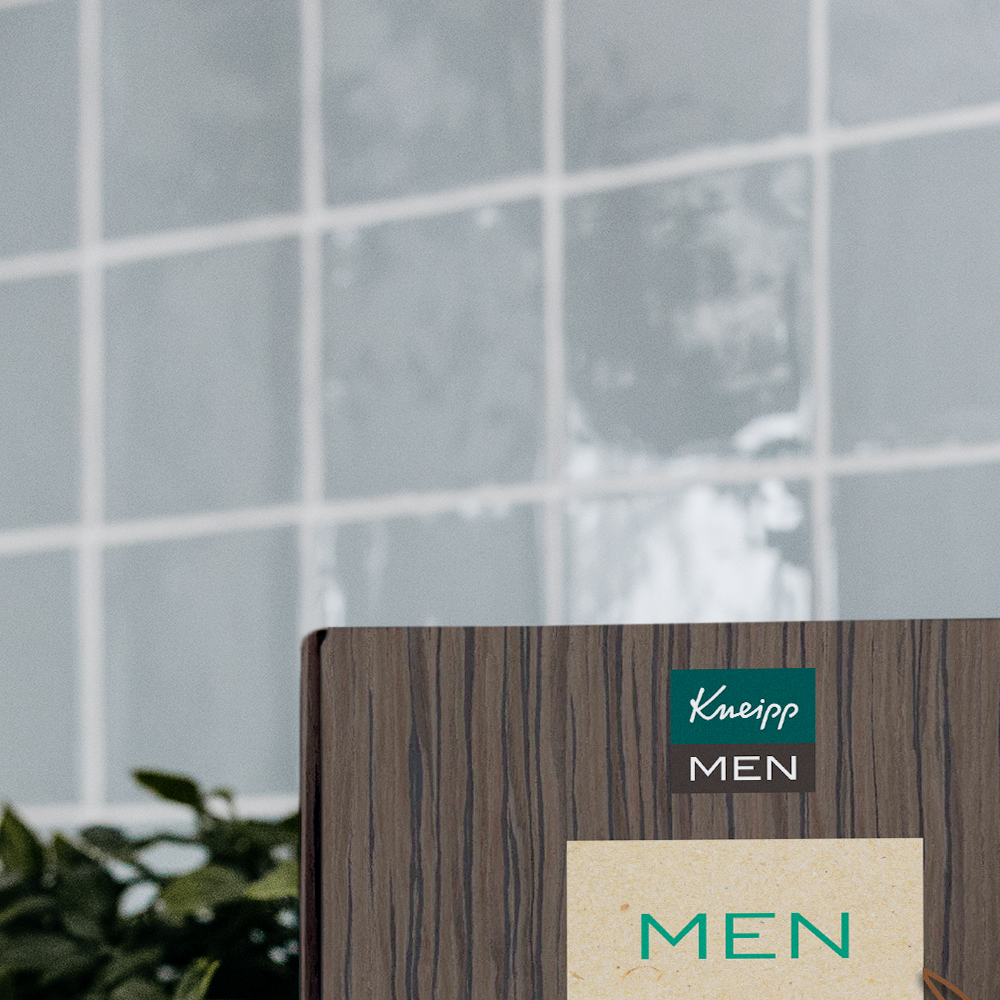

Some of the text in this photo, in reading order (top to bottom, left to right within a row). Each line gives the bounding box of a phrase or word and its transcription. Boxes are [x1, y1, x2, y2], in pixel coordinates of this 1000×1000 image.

[689, 684, 799, 731] Kneipp
[690, 755, 797, 782] MEN
[640, 912, 850, 960] MEN
